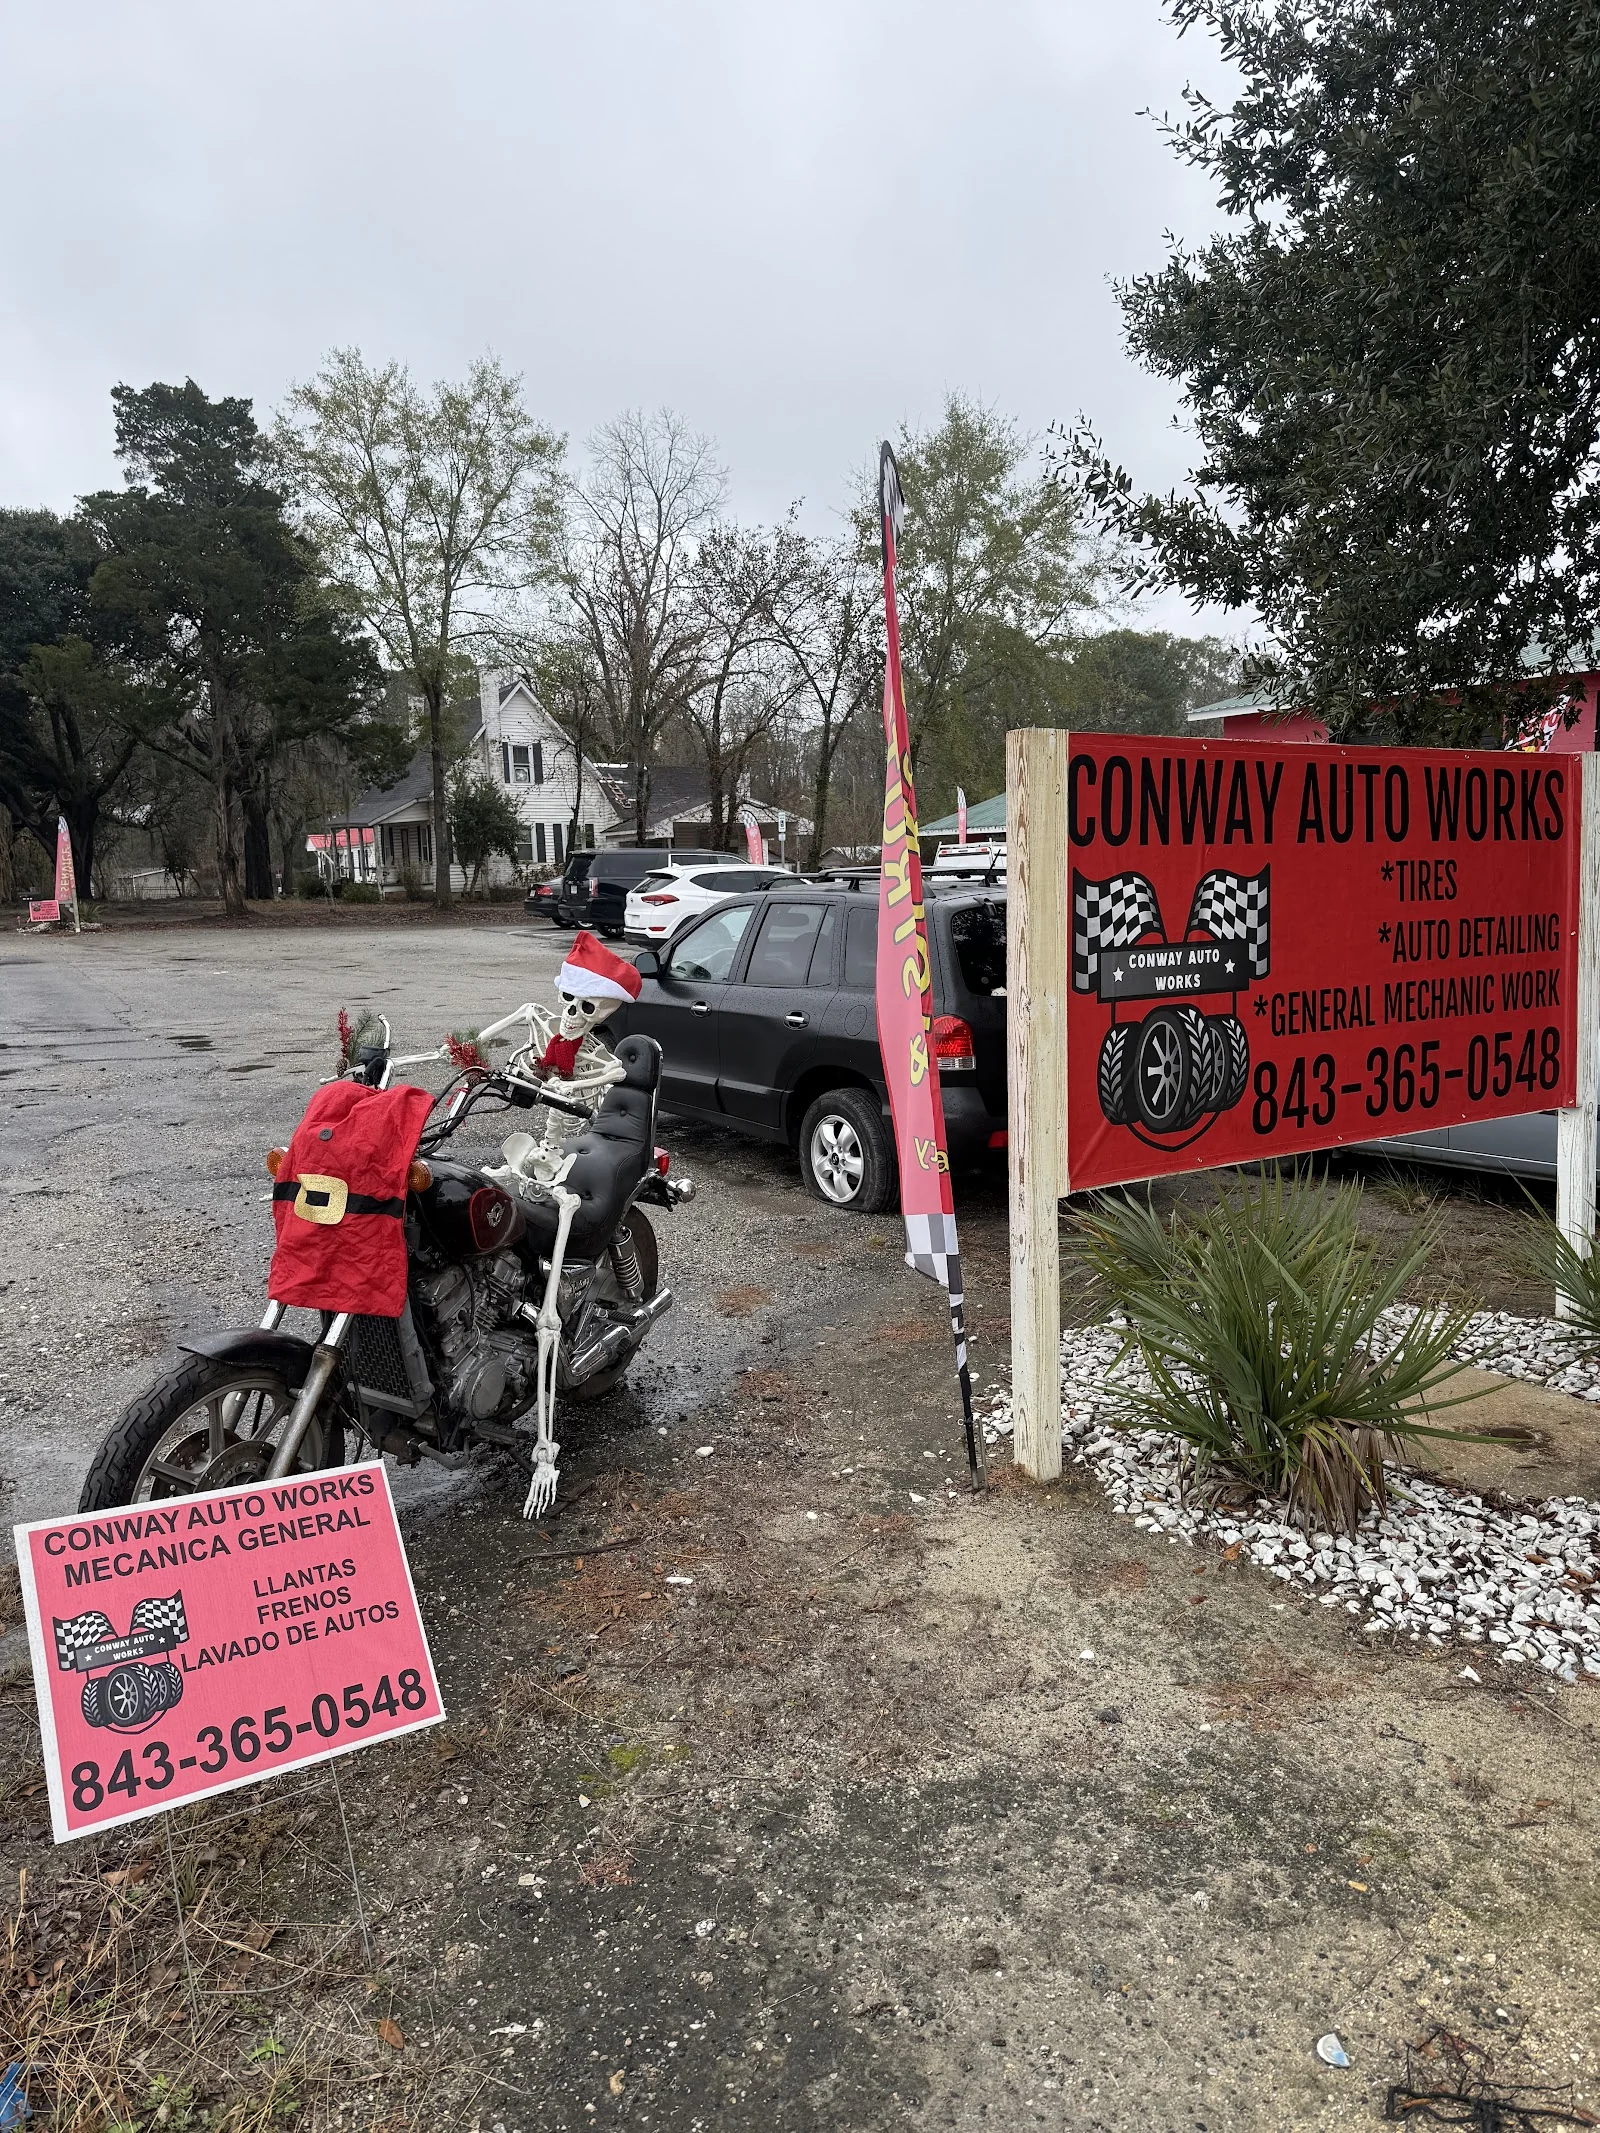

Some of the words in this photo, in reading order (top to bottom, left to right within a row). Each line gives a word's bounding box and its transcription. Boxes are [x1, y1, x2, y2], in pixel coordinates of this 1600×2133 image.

[1068, 753, 1285, 848] CONWAY
[1296, 762, 1410, 844] AUTO
[1423, 766, 1564, 842] WORKS
[1128, 951, 1183, 969] CONWAY
[1187, 948, 1220, 965] AUTO
[1458, 912, 1560, 959] DETAILING
[1154, 973, 1201, 991] WORKS
[1384, 974, 1495, 1025] MECHANIC
[1501, 968, 1561, 1012] WORK
[1252, 1026, 1561, 1135] 843-365-0548
[44, 1509, 180, 1556] CONWAY
[187, 1495, 266, 1530] AUTO
[271, 1473, 375, 1512] WORKS
[64, 1534, 232, 1588] MECANICA
[237, 1506, 371, 1551] GENERAL
[253, 1558, 357, 1598] LLANTAS
[256, 1586, 352, 1625] FRENOS
[94, 1639, 130, 1654] CONWAY
[133, 1633, 155, 1645] AUTO
[112, 1646, 144, 1661] WORKS
[182, 1631, 280, 1673] LAVADO
[285, 1620, 319, 1646] DE
[324, 1600, 400, 1637] AUTOS
[71, 1668, 427, 1812] 843-365-0548
